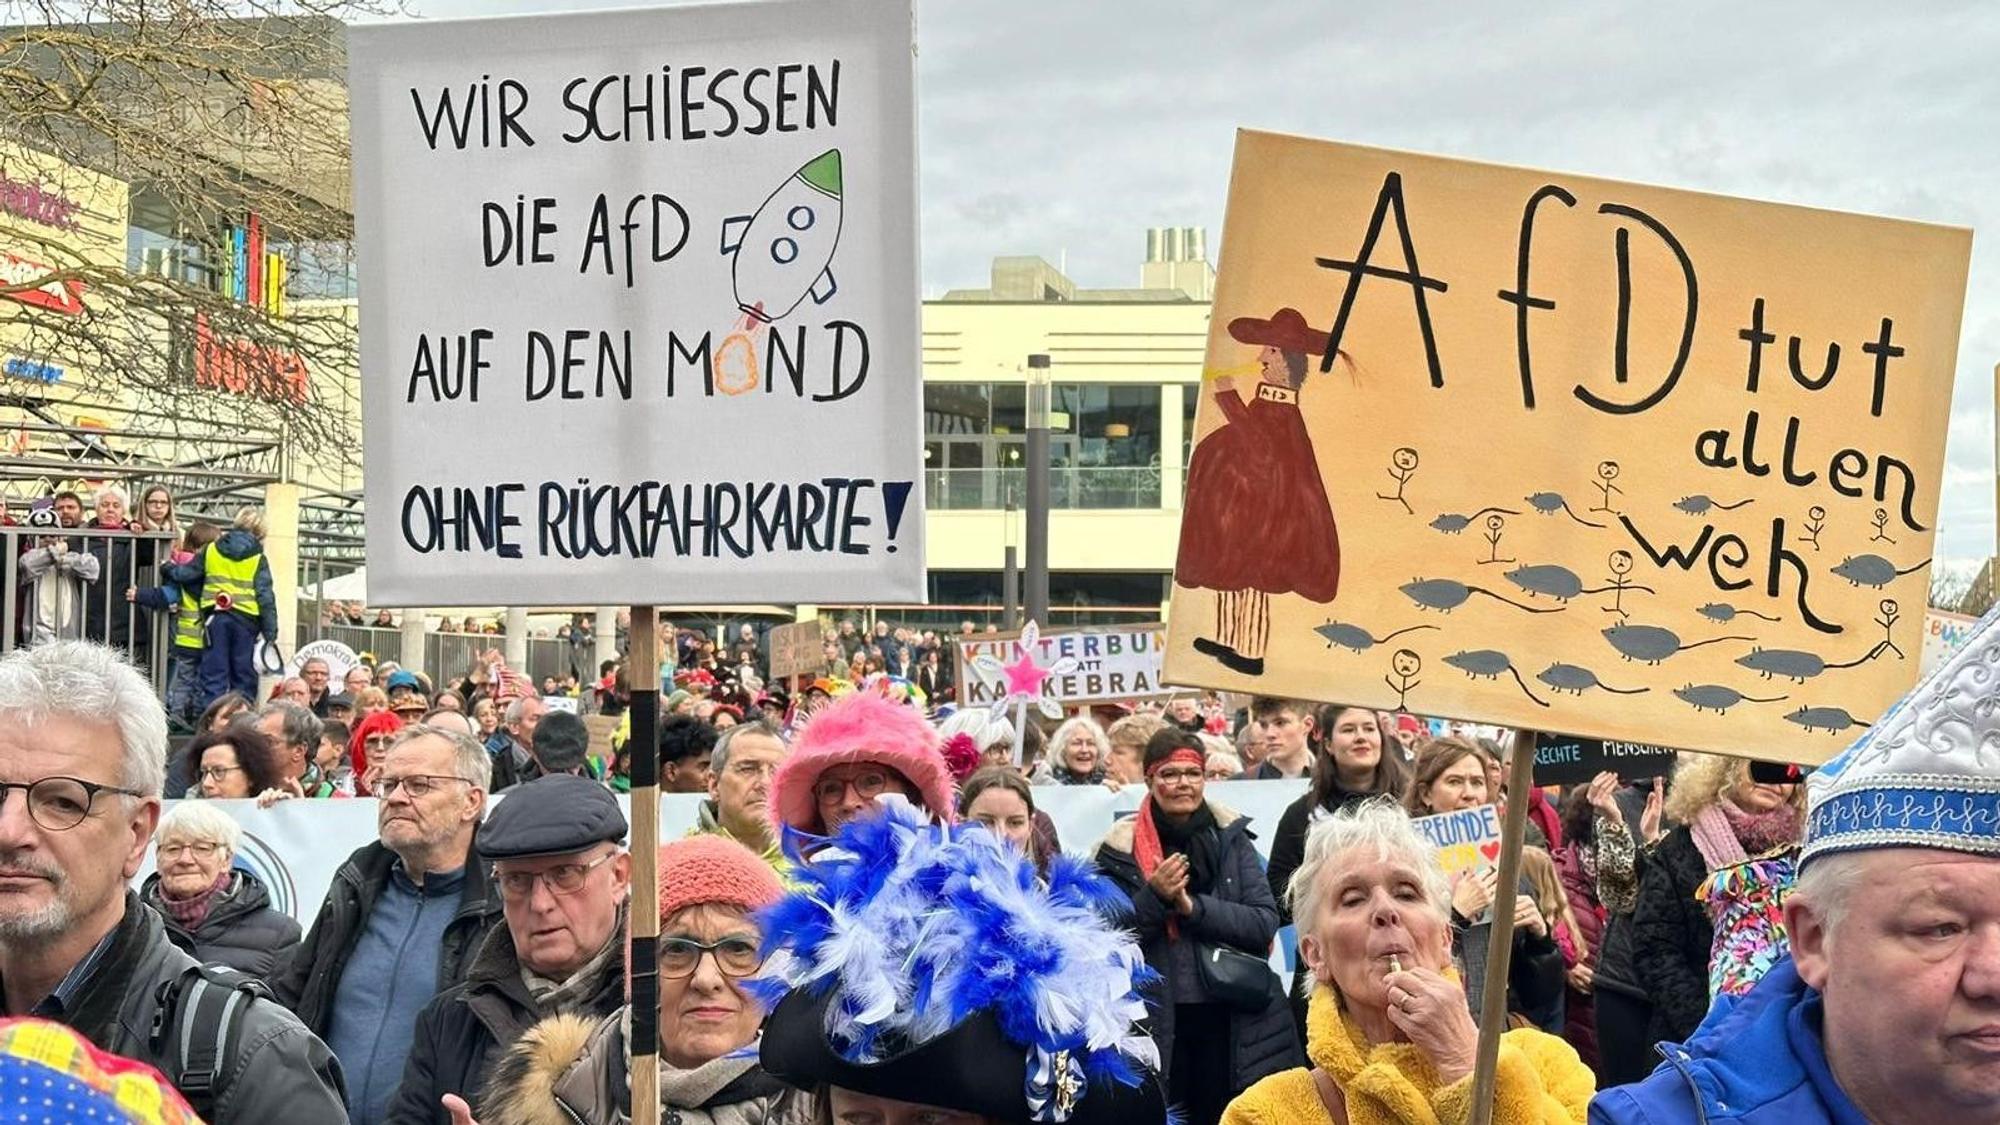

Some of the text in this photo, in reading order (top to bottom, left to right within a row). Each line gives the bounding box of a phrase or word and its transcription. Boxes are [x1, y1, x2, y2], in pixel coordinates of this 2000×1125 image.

[580, 193, 690, 289] AfD
[1315, 172, 1699, 415] AfD
[407, 320, 870, 403] AUF DEN MOND
[1739, 298, 1905, 417] tut
[401, 477, 914, 560] OHNE RÜCKFAHRKARTE!
[1695, 410, 1930, 531] allen
[1617, 512, 1844, 634] weh
[965, 633, 1165, 662] KUNTERBUN
[1077, 660, 1101, 672] ATT
